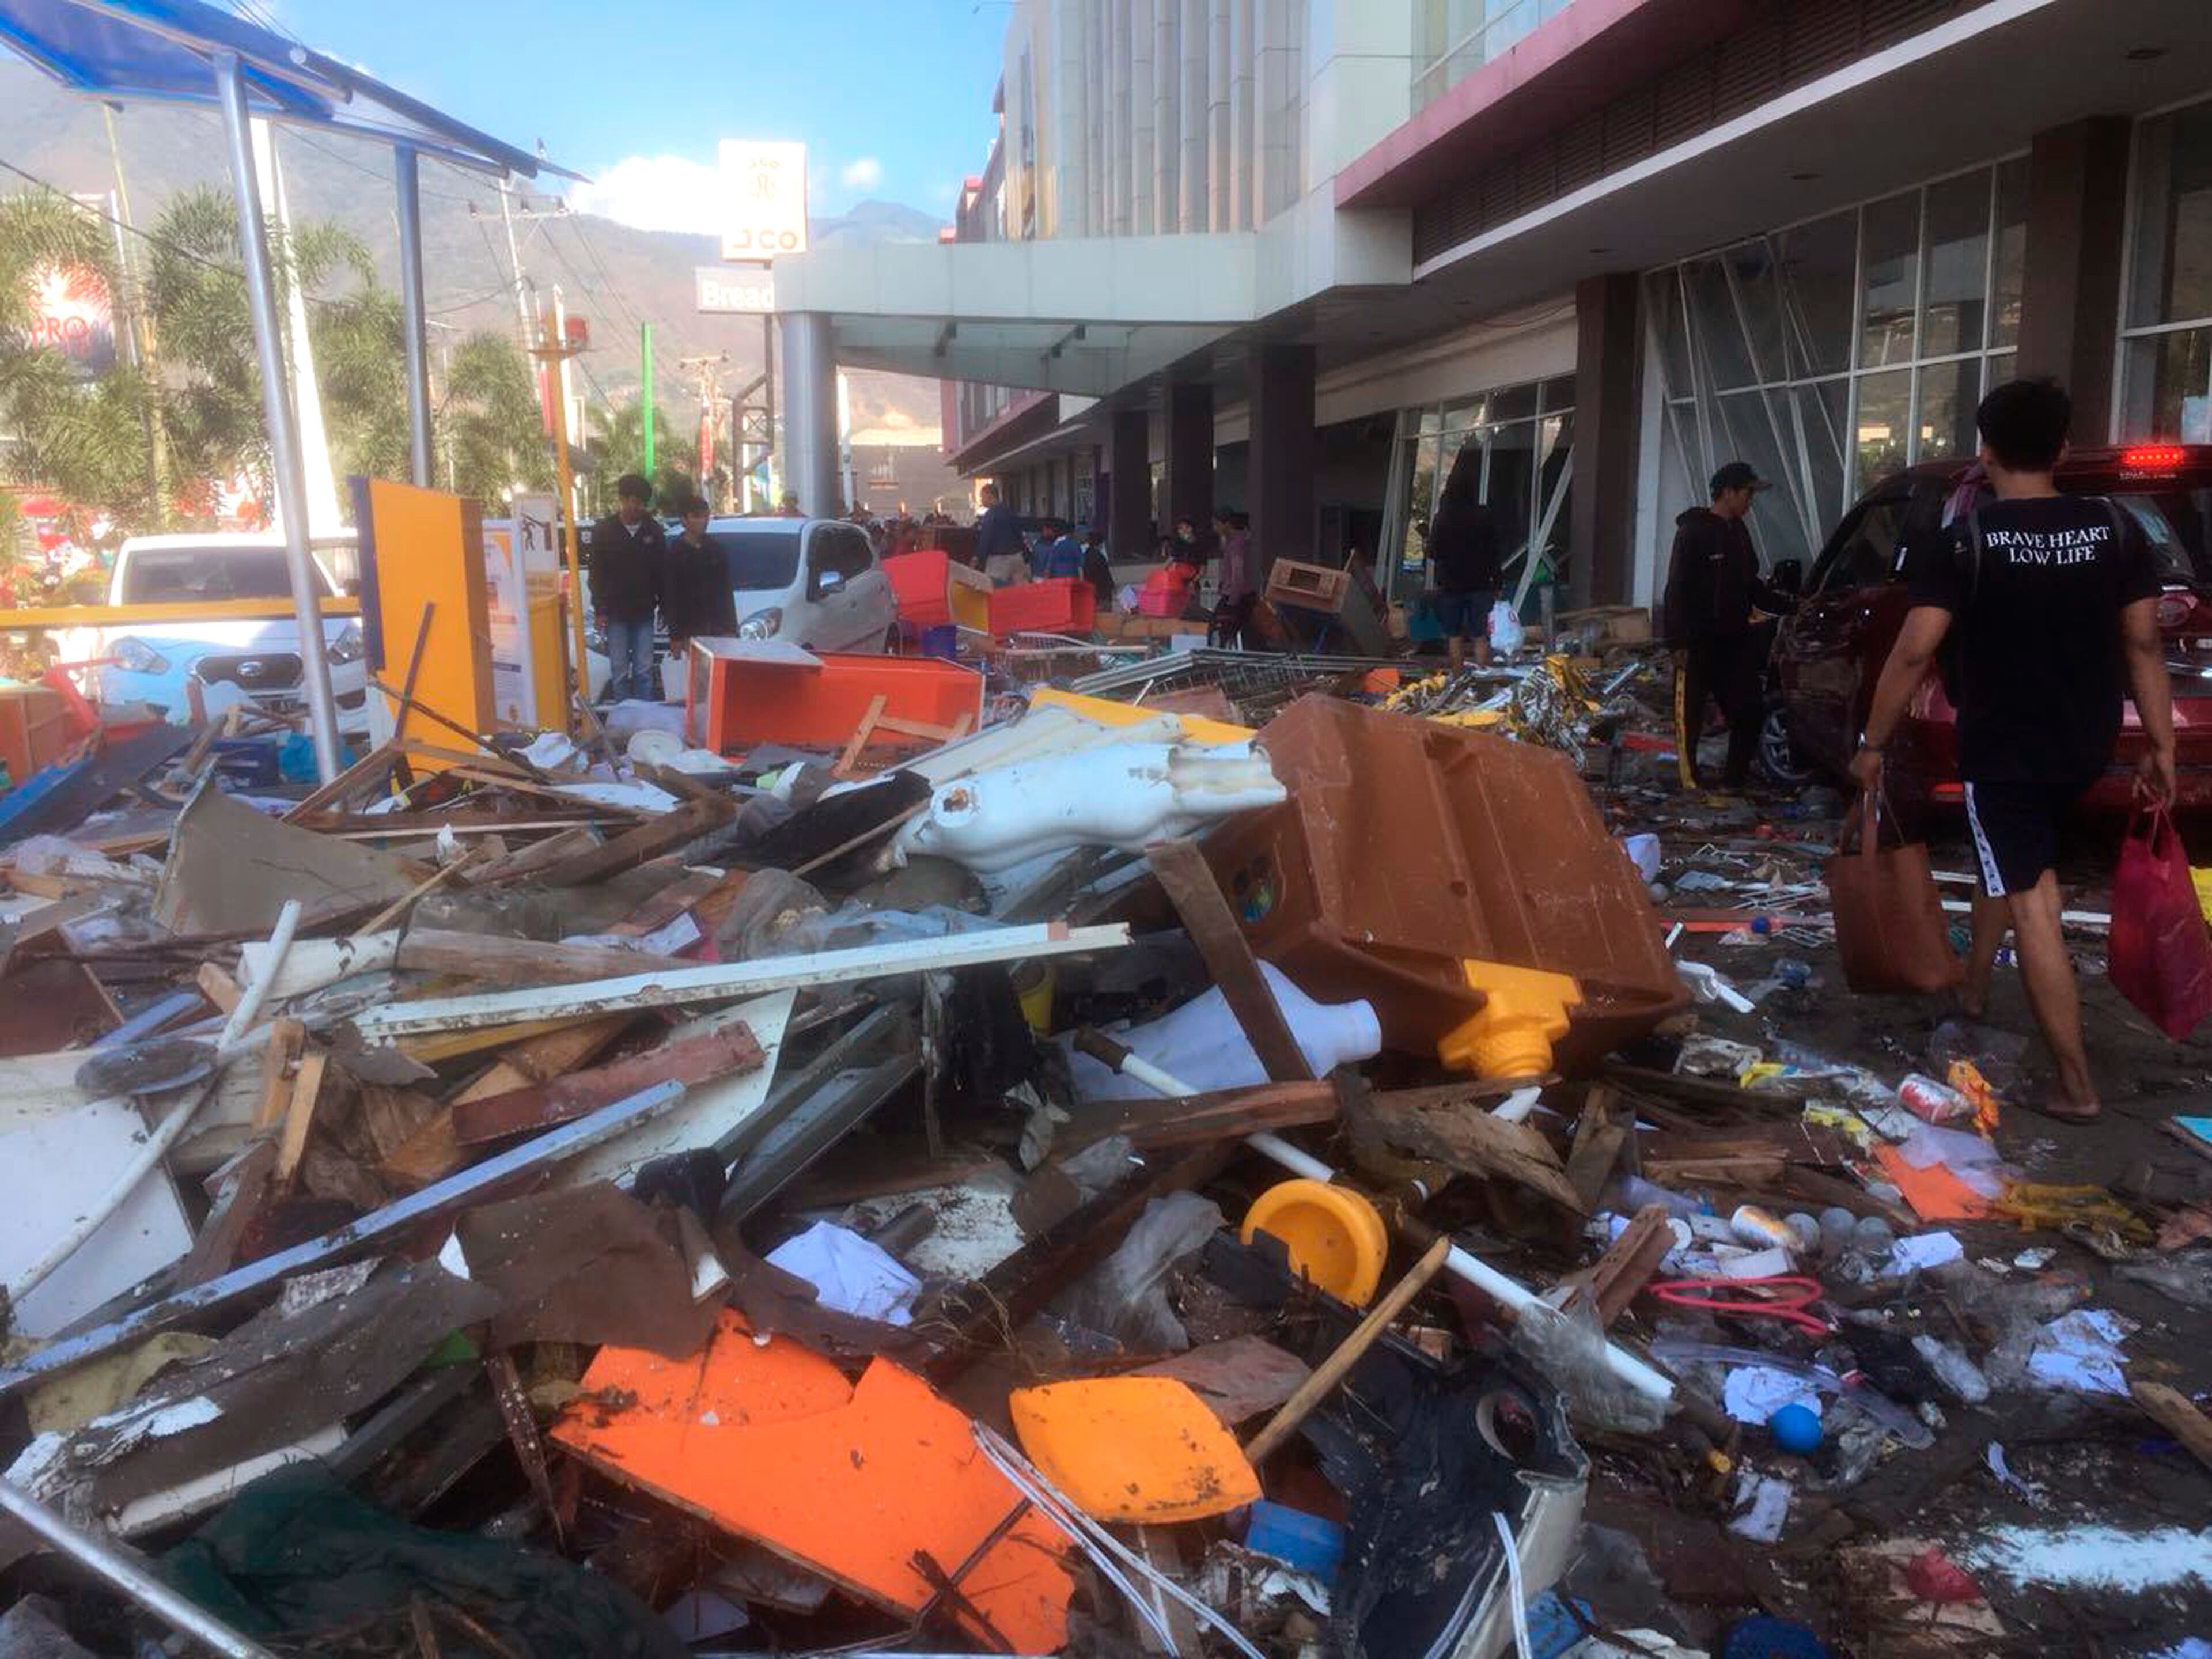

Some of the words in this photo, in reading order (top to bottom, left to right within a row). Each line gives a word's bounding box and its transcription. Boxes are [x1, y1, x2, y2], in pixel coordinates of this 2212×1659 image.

[1986, 531, 2044, 548] BRAVE
[2050, 526, 2109, 548] HEART
[2009, 547, 2050, 565] LOW
[2056, 545, 2096, 565] LIFE
